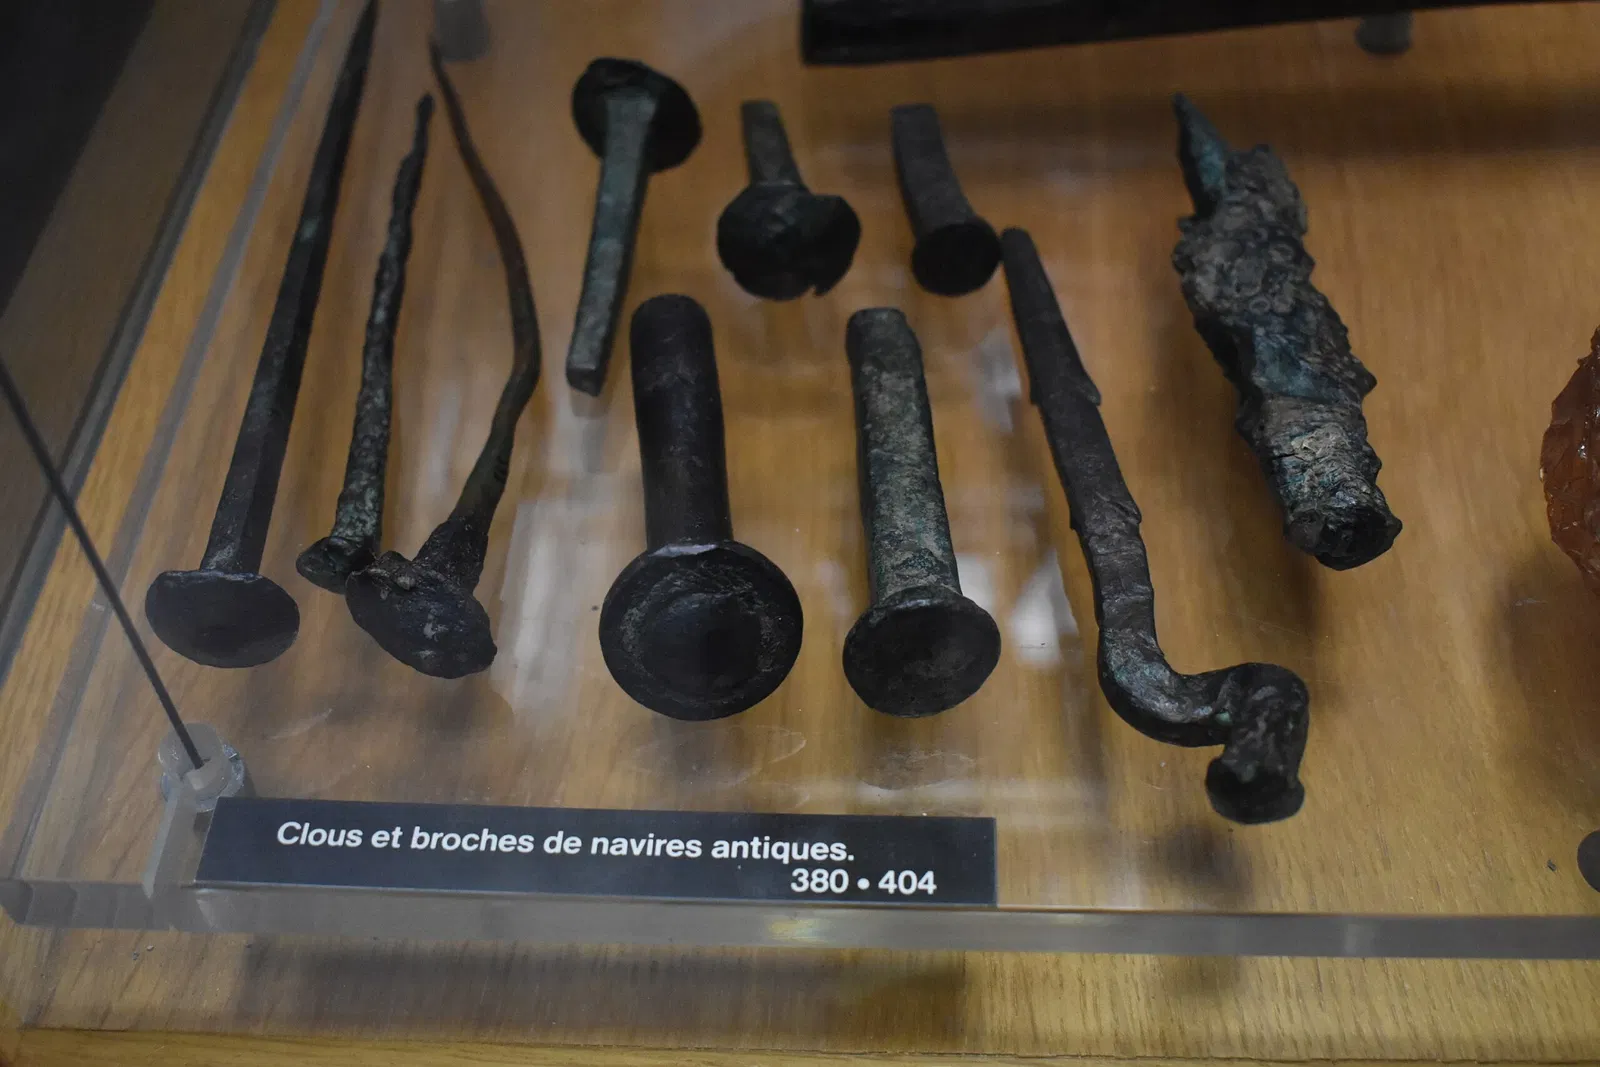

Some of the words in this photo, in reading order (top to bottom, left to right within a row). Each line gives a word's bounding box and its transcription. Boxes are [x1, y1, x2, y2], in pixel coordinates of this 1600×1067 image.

[277, 821, 364, 848] Clous
[371, 826, 403, 849] et
[410, 825, 535, 853] broches
[543, 830, 583, 855] de
[590, 832, 703, 858] navires
[710, 835, 855, 865] antiques.
[790, 867, 849, 894] 380
[878, 869, 937, 895] 404
